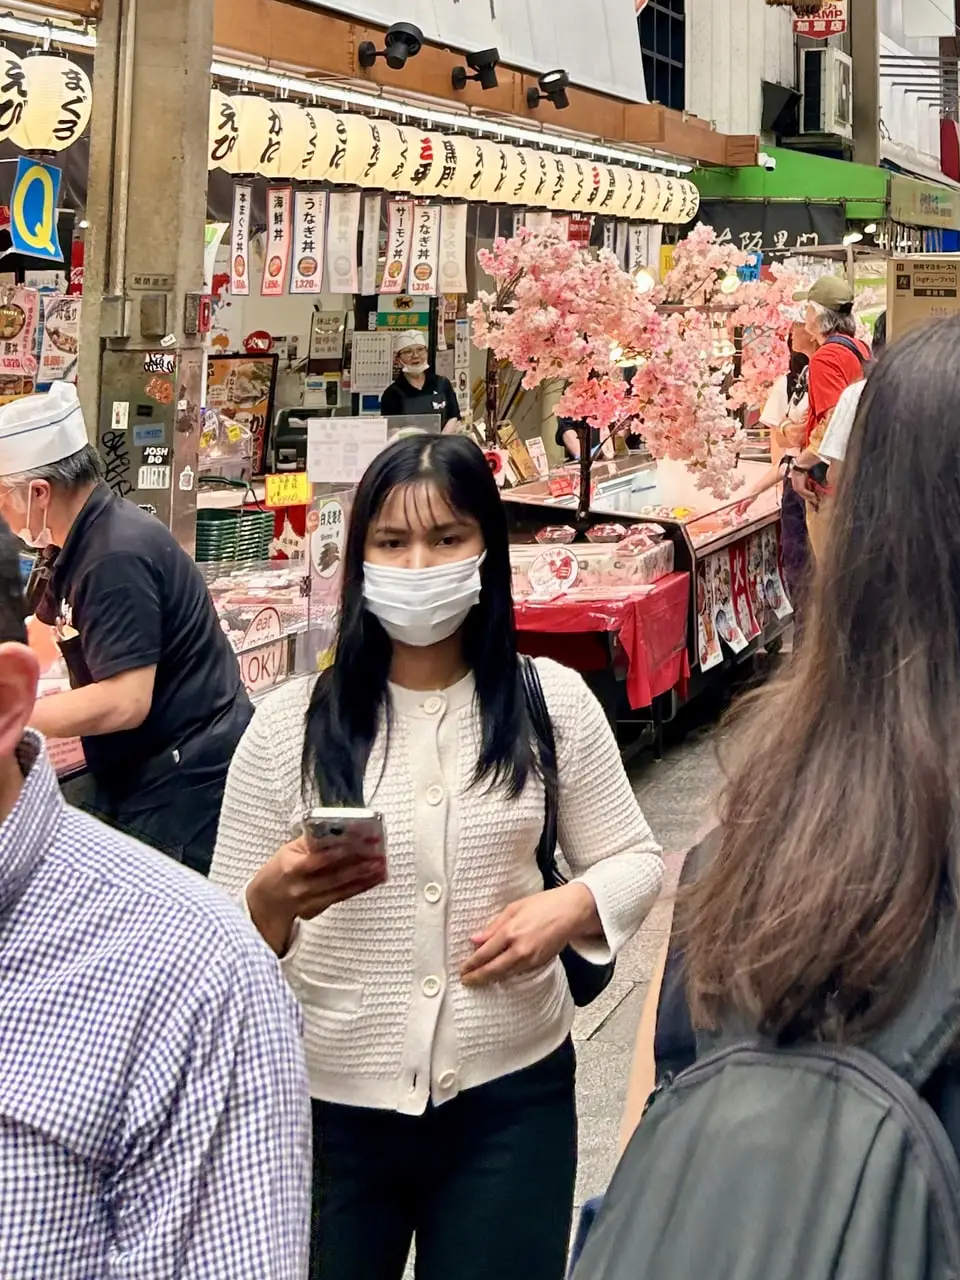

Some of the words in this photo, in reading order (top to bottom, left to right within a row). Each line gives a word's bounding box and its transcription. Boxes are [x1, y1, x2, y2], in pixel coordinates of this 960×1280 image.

[797, 10, 843, 19] AMP
[52, 68, 87, 141] まぐろ
[211, 103, 239, 161] えび
[260, 108, 283, 163] かに
[13, 165, 57, 254] Q
[273, 195, 284, 242] 海鮮丼
[301, 197, 316, 253] うなぎ丼
[393, 206, 406, 259] サーモン丼
[418, 211, 431, 260] うなぎ丼
[143, 446, 169, 456] JOSH
[256, 614, 272, 632] eat
[248, 651, 276, 683] OK!
